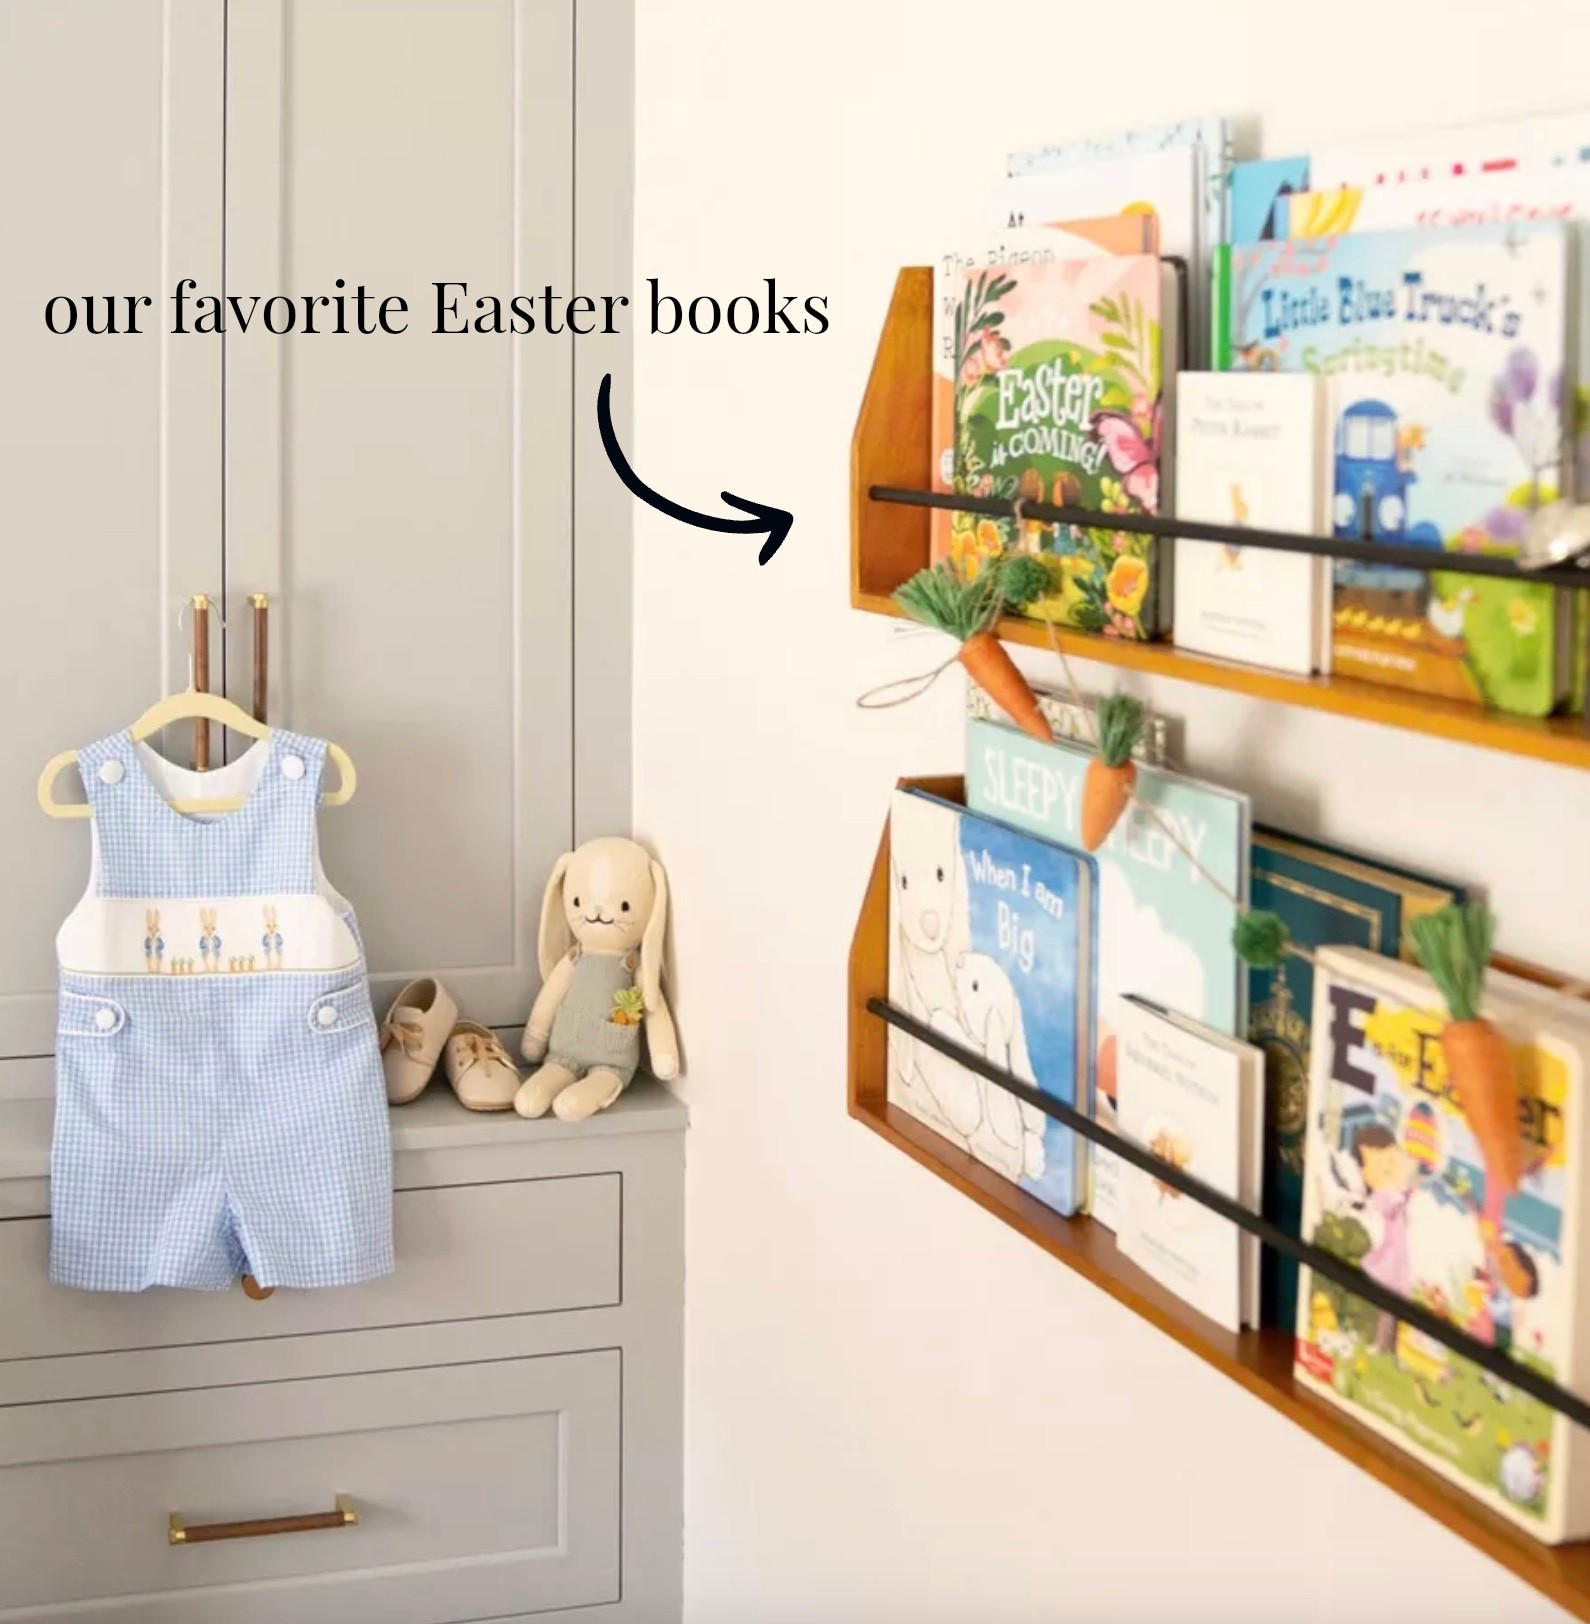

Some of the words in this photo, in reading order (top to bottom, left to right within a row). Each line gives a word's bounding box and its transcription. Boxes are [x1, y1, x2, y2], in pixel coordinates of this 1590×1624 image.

[942, 252, 975, 277] The
[1261, 286, 1330, 339] Little
[1337, 276, 1396, 325] Blue
[994, 357, 1105, 431] Easter
[989, 440, 1008, 469] is
[1008, 425, 1108, 475] COMING!
[983, 746, 1080, 834] SLEEPY
[969, 849, 1017, 890] When
[1020, 863, 1032, 898] I
[1034, 880, 1065, 919] am
[996, 901, 1036, 973] Big
[1329, 984, 1377, 1096] E
